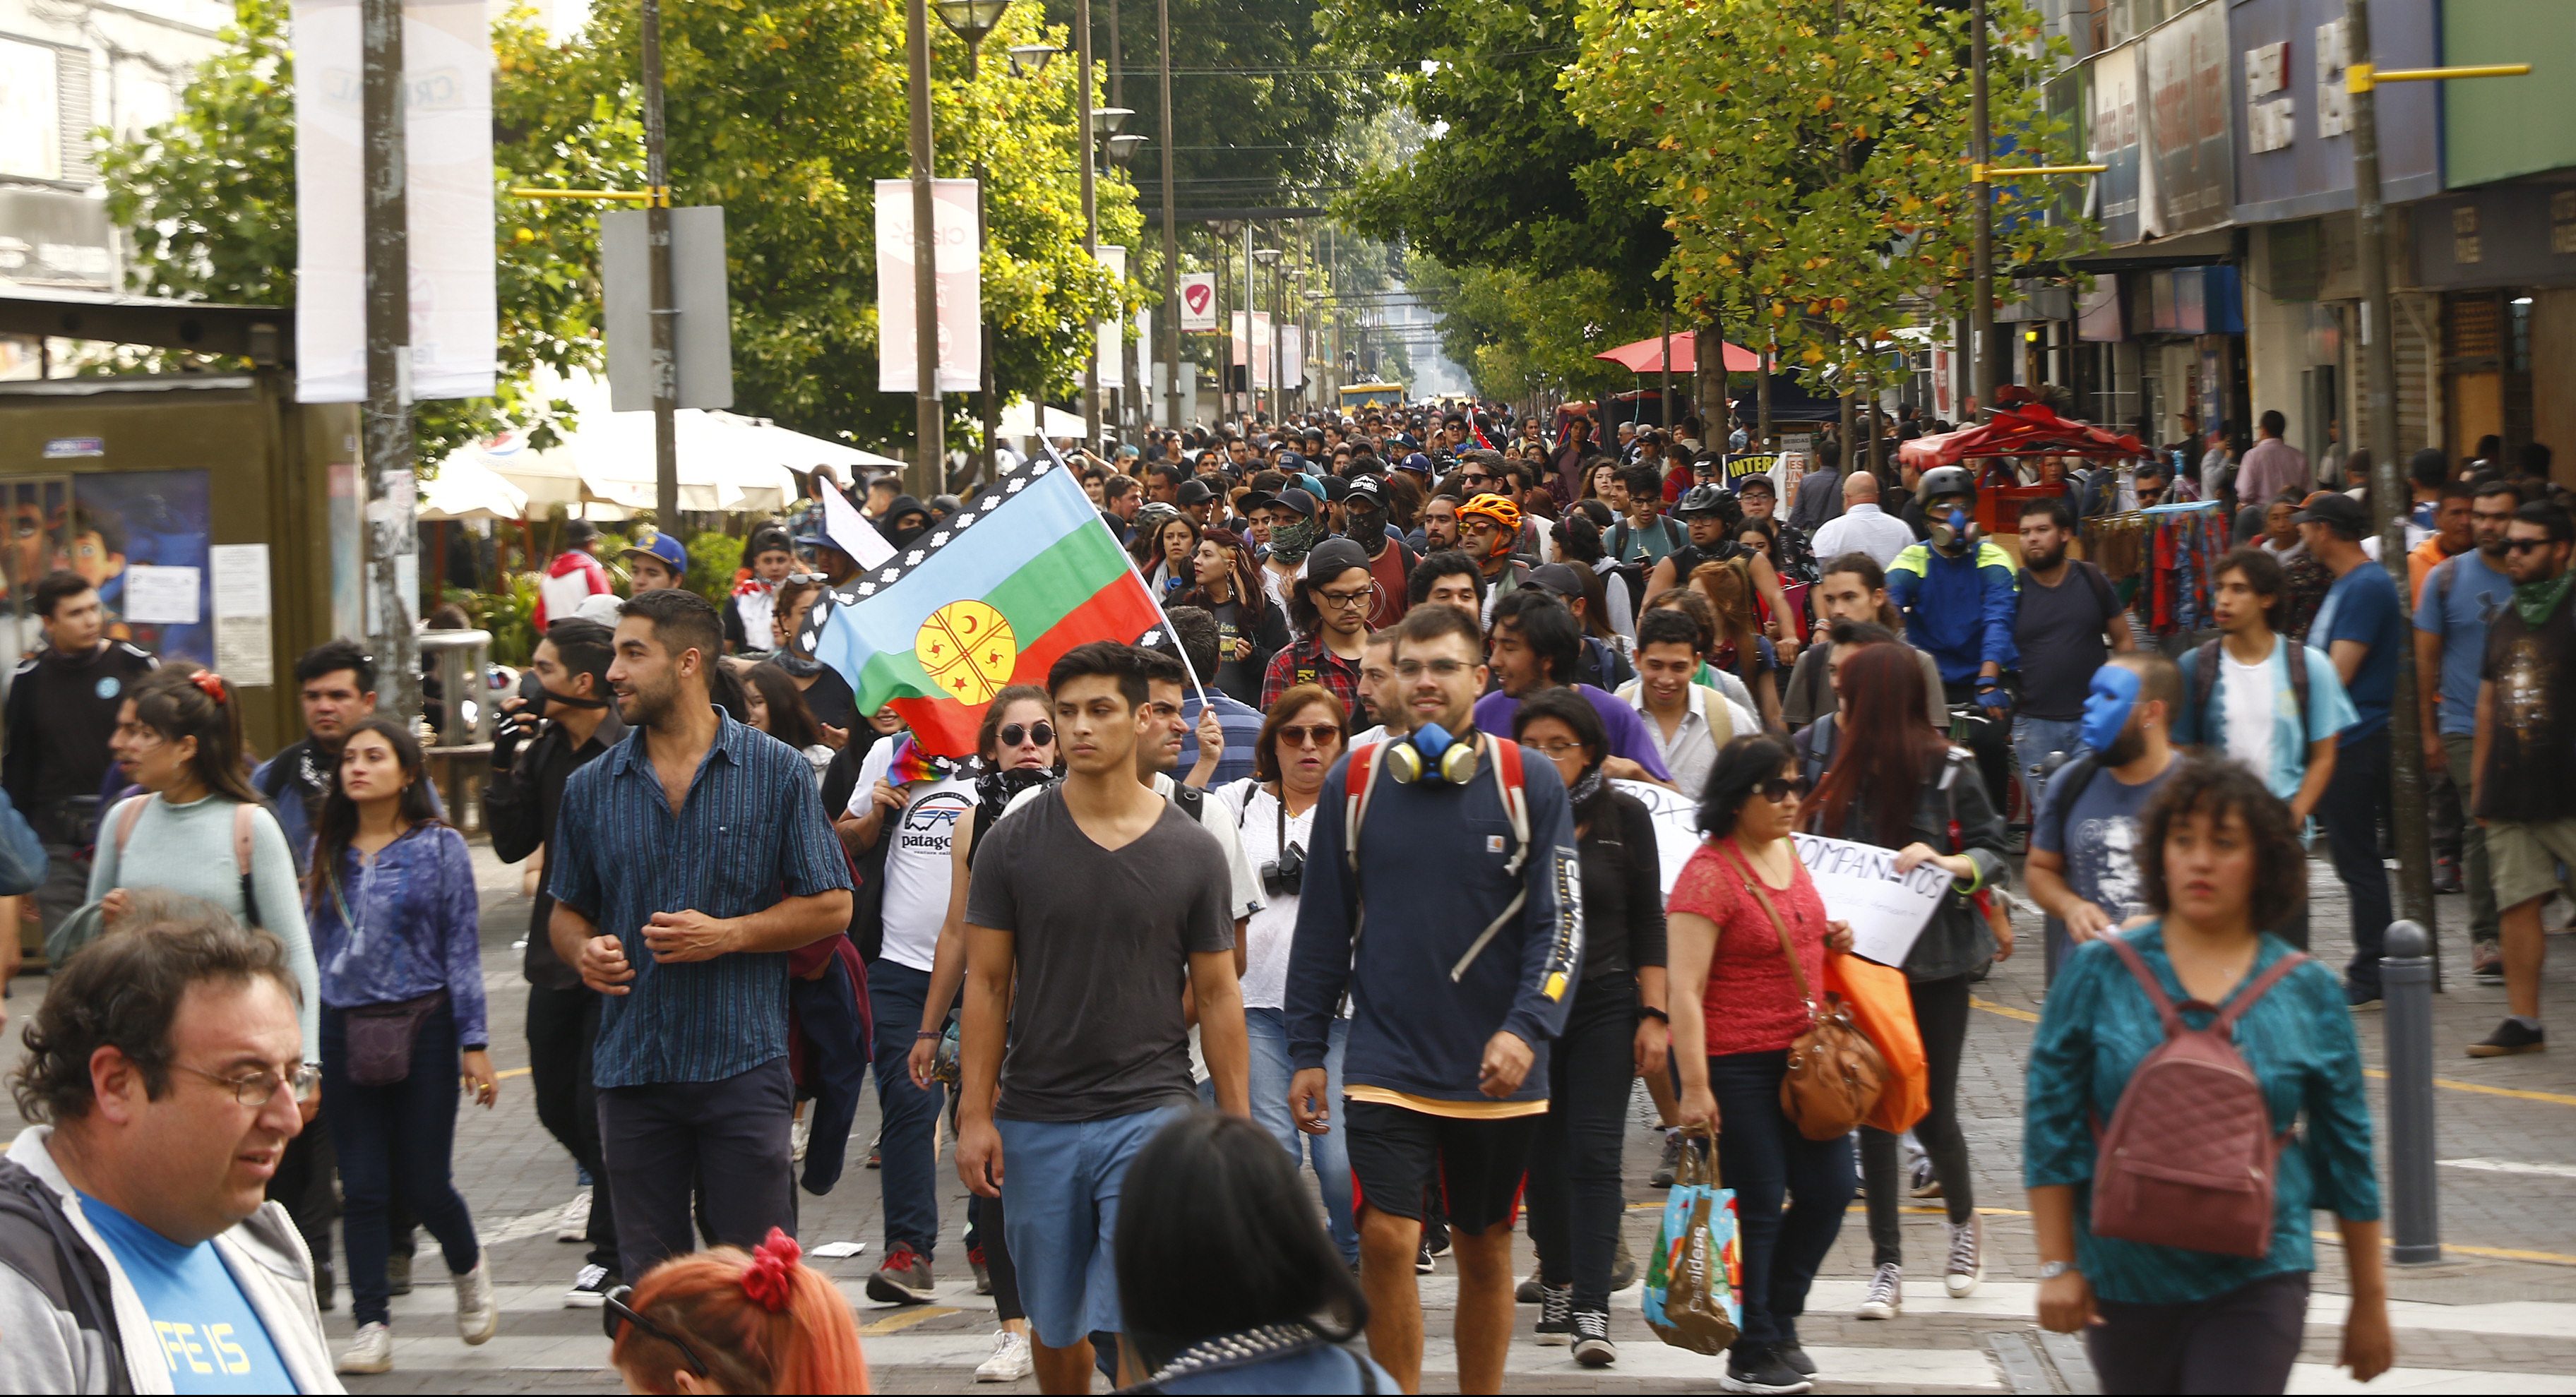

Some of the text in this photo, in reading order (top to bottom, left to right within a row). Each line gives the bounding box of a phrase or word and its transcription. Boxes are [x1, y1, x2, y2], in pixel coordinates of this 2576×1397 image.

[902, 835, 952, 851] patago
[152, 1320, 251, 1375] FE IS
